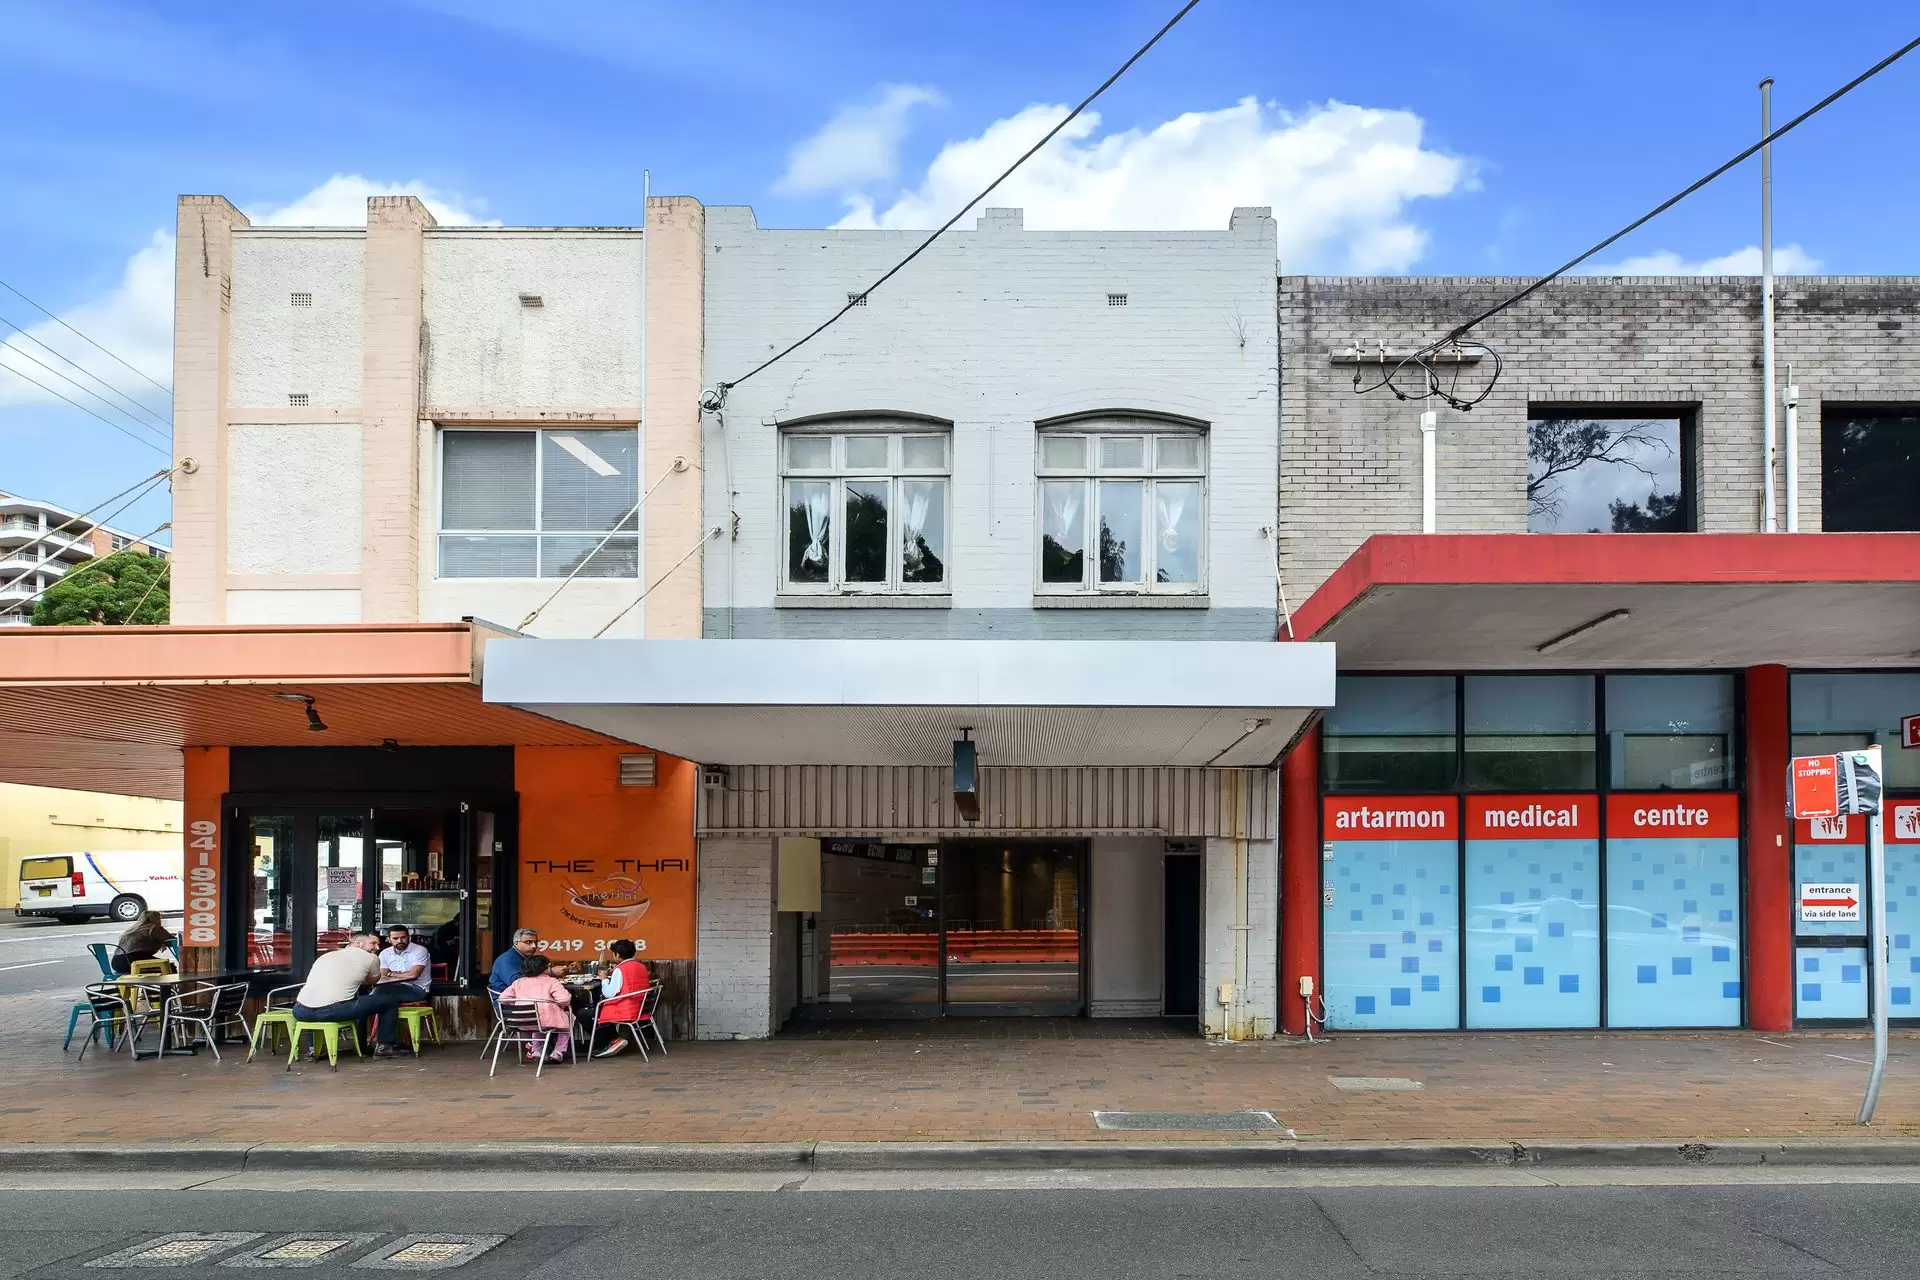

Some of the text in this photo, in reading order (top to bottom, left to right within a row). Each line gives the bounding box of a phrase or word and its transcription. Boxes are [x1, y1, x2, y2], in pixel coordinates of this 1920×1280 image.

[1798, 768, 1832, 777] STOPPING
[1335, 804, 1709, 829] artarmon medical centre
[525, 859, 689, 873] THE THAI
[1809, 886, 1852, 894] entrance
[604, 921, 619, 929] Thai
[537, 939, 647, 952] 9419 38
